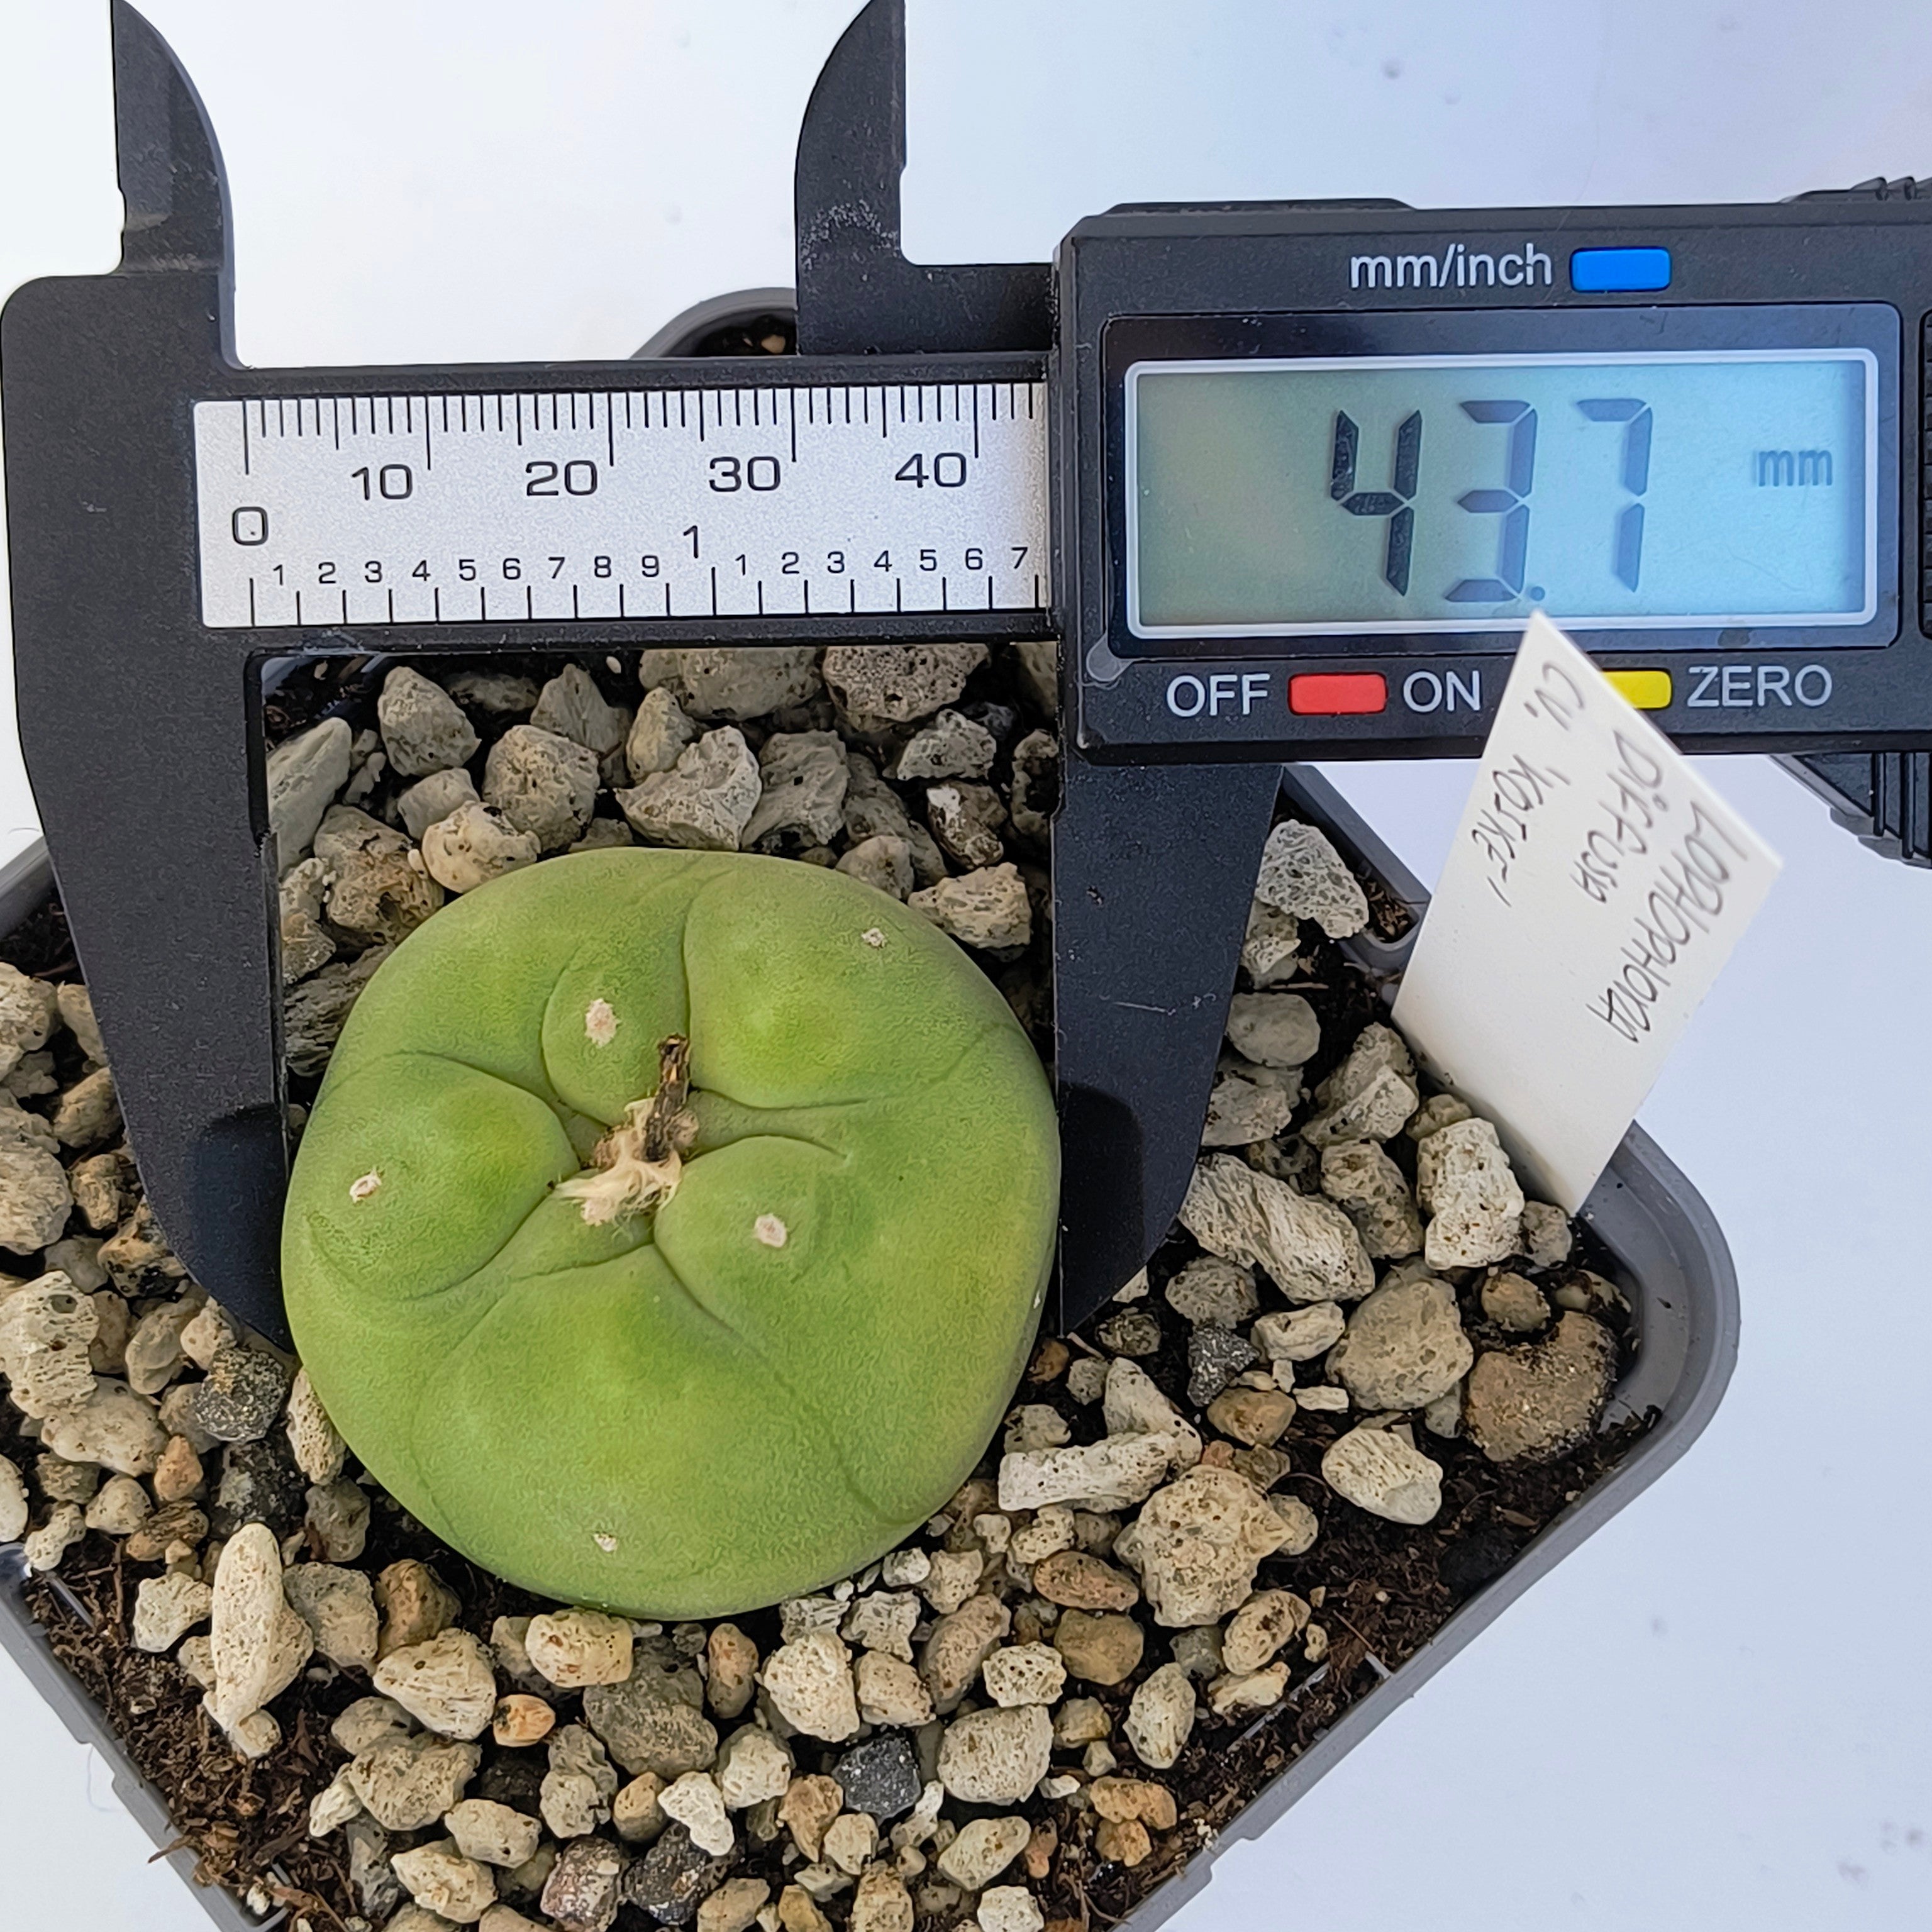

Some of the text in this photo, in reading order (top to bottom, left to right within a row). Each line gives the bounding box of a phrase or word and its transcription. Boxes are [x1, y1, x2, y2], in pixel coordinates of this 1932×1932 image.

[1350, 243, 1552, 289] mm/inch
[352, 452, 967, 501] 10 20 30 40
[1330, 397, 1834, 602] 43.7 mm
[232, 506, 699, 559] 0 1
[273, 547, 1028, 586] 1 2 3 4 5 6 7 8 9 1 2 3 4 5 6 7
[1167, 672, 1271, 717] OFF
[1403, 670, 1481, 712] ON
[1688, 664, 1833, 708] ZERO
[1586, 800, 1748, 1043] LOPHOPHORA
